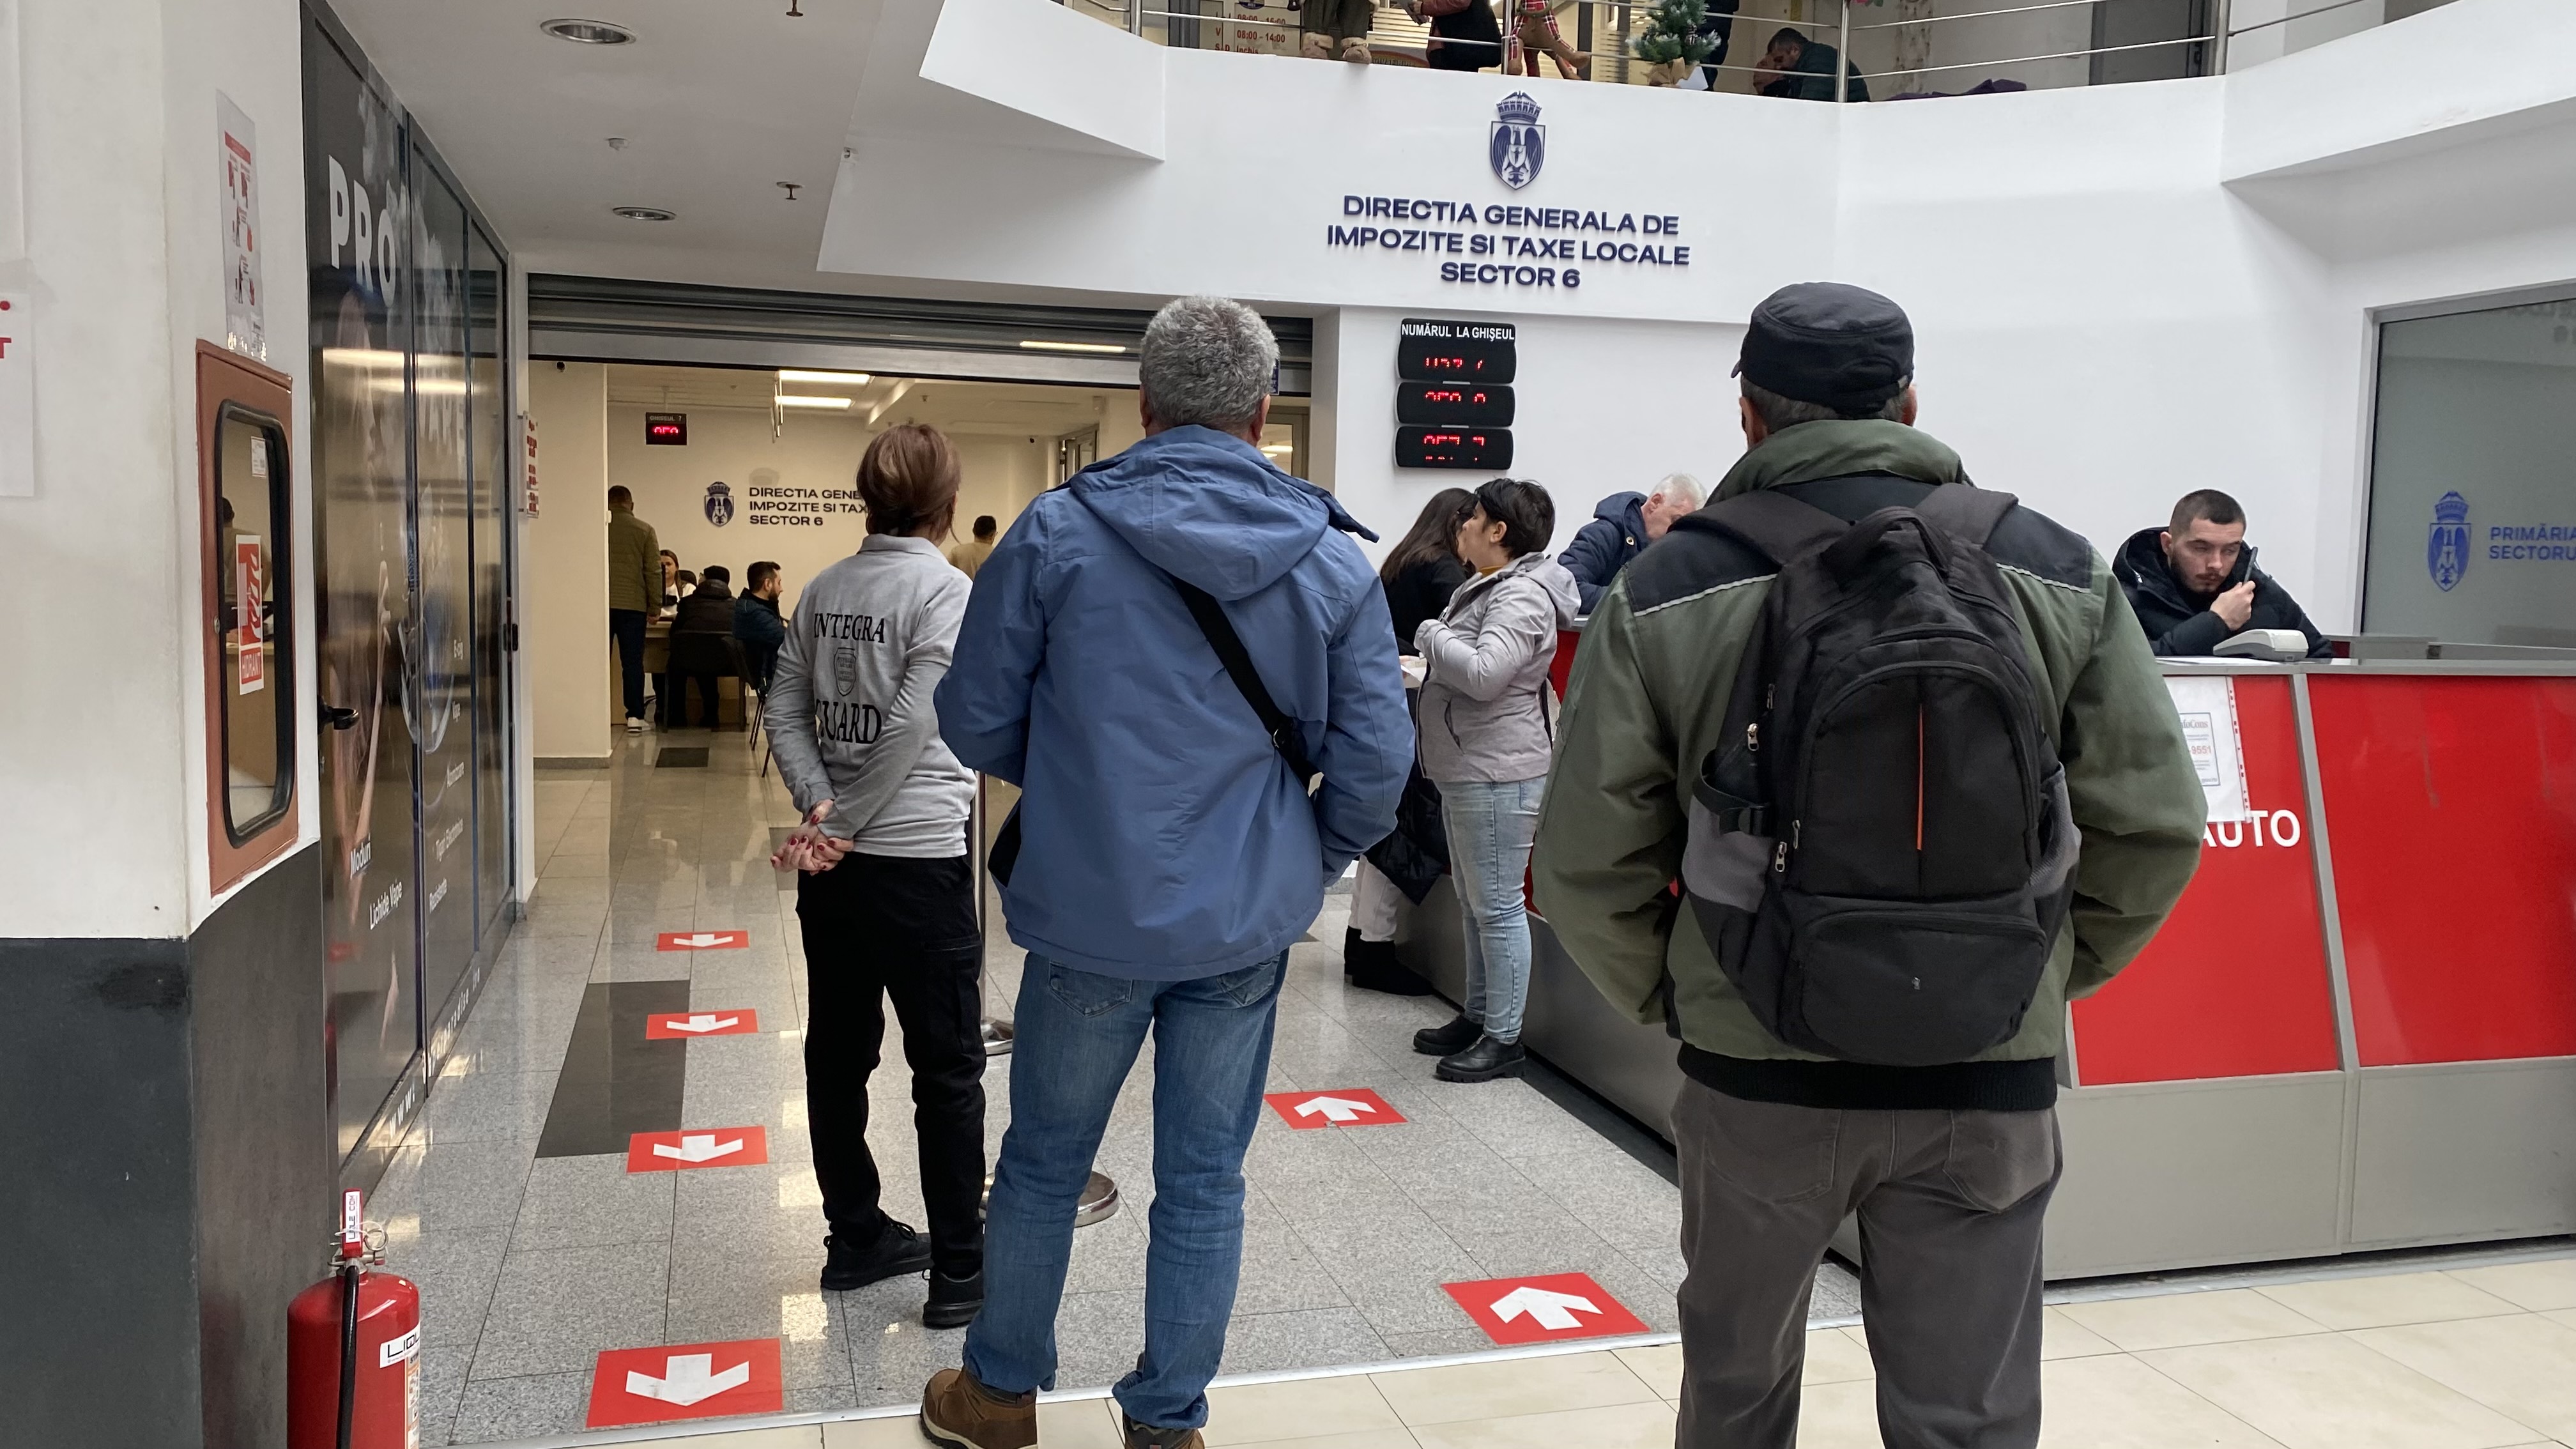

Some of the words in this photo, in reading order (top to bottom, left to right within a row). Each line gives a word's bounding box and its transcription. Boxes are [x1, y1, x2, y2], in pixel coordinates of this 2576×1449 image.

[1237, 29, 1257, 40] 08:00
[1266, 33, 1285, 42] 14:00
[1344, 195, 1478, 223] DIRECTIA
[1484, 204, 1637, 232] GENERALA
[1643, 214, 1679, 234] DE
[328, 154, 396, 308] PRO
[1328, 224, 1464, 252] IMPOZITE
[1469, 234, 1495, 254] SI
[1502, 235, 1575, 259] TAXE
[1582, 240, 1690, 265] LOCALE
[1441, 261, 1556, 288] SECTOR
[1562, 268, 1581, 288] 6
[1401, 323, 1452, 337] NUMĂRUL
[1456, 326, 1469, 338] LA
[749, 487, 818, 498] DIRECTIA
[749, 501, 819, 512] IMPOZITE
[823, 503, 836, 512] SI
[749, 515, 810, 526] SECTOR
[814, 516, 824, 526] 6
[814, 613, 885, 644] INTEGRA
[350, 832, 371, 880] Moduri
[389, 880, 402, 908] Vape
